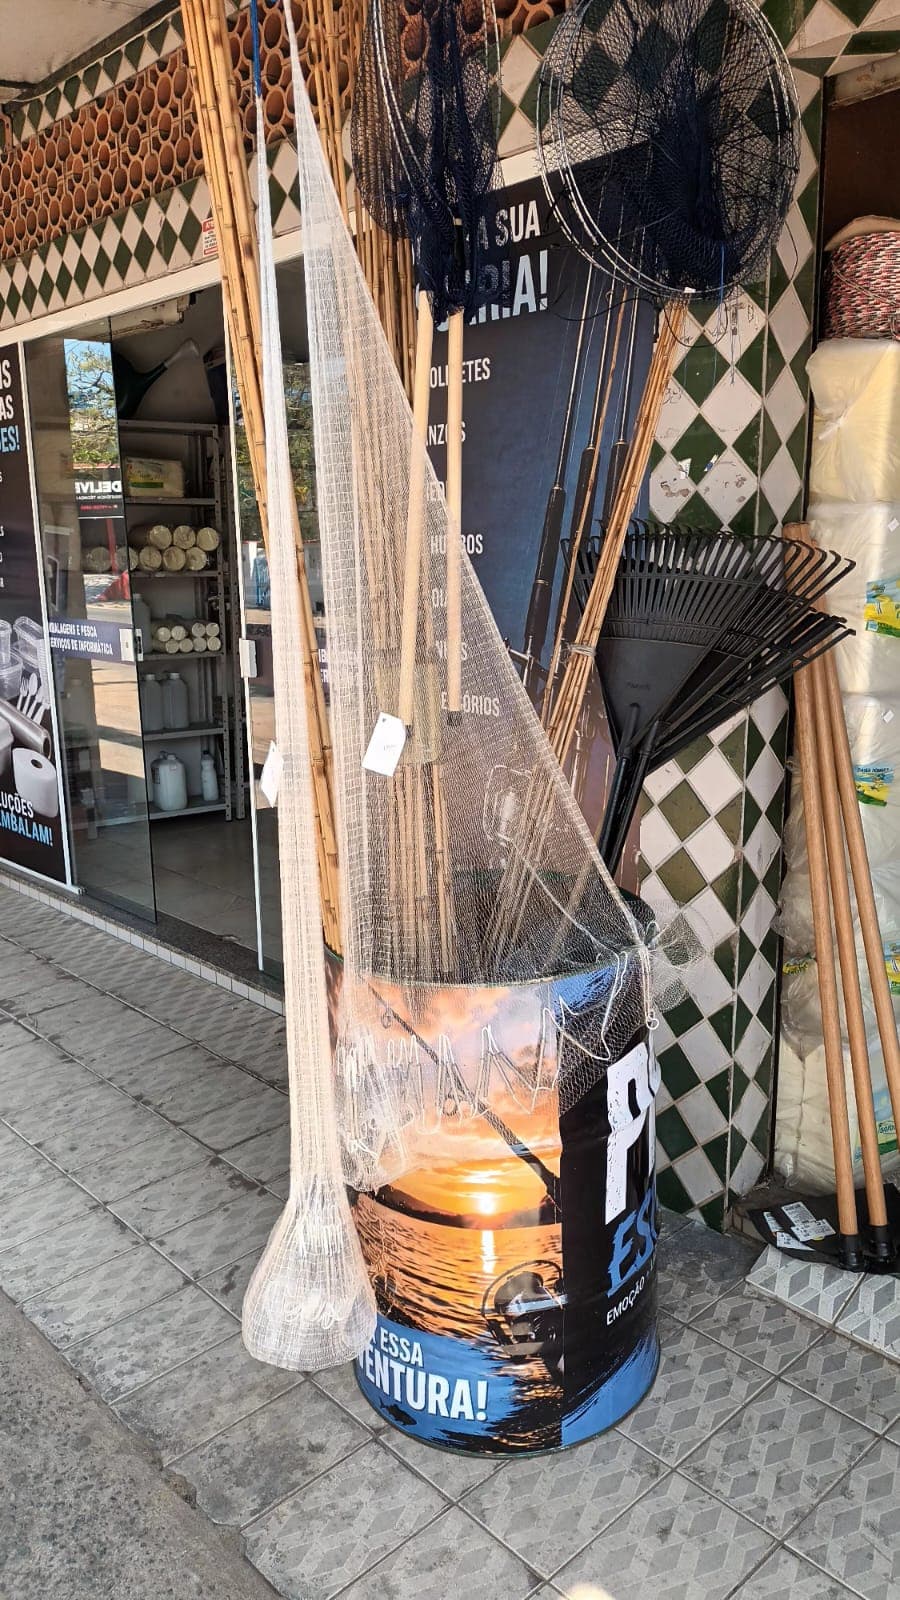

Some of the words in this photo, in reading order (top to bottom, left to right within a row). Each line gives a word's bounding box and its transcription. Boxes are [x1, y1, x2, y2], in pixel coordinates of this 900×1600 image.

[496, 200, 541, 247] SUA
[430, 357, 490, 388] OLIETES
[0, 424, 20, 453] ES!
[0, 791, 34, 818] UÇÕES
[0, 810, 53, 847] MBALAM!
[606, 1276, 646, 1326] EMOÇÃO
[380, 1327, 424, 1368] ESSA
